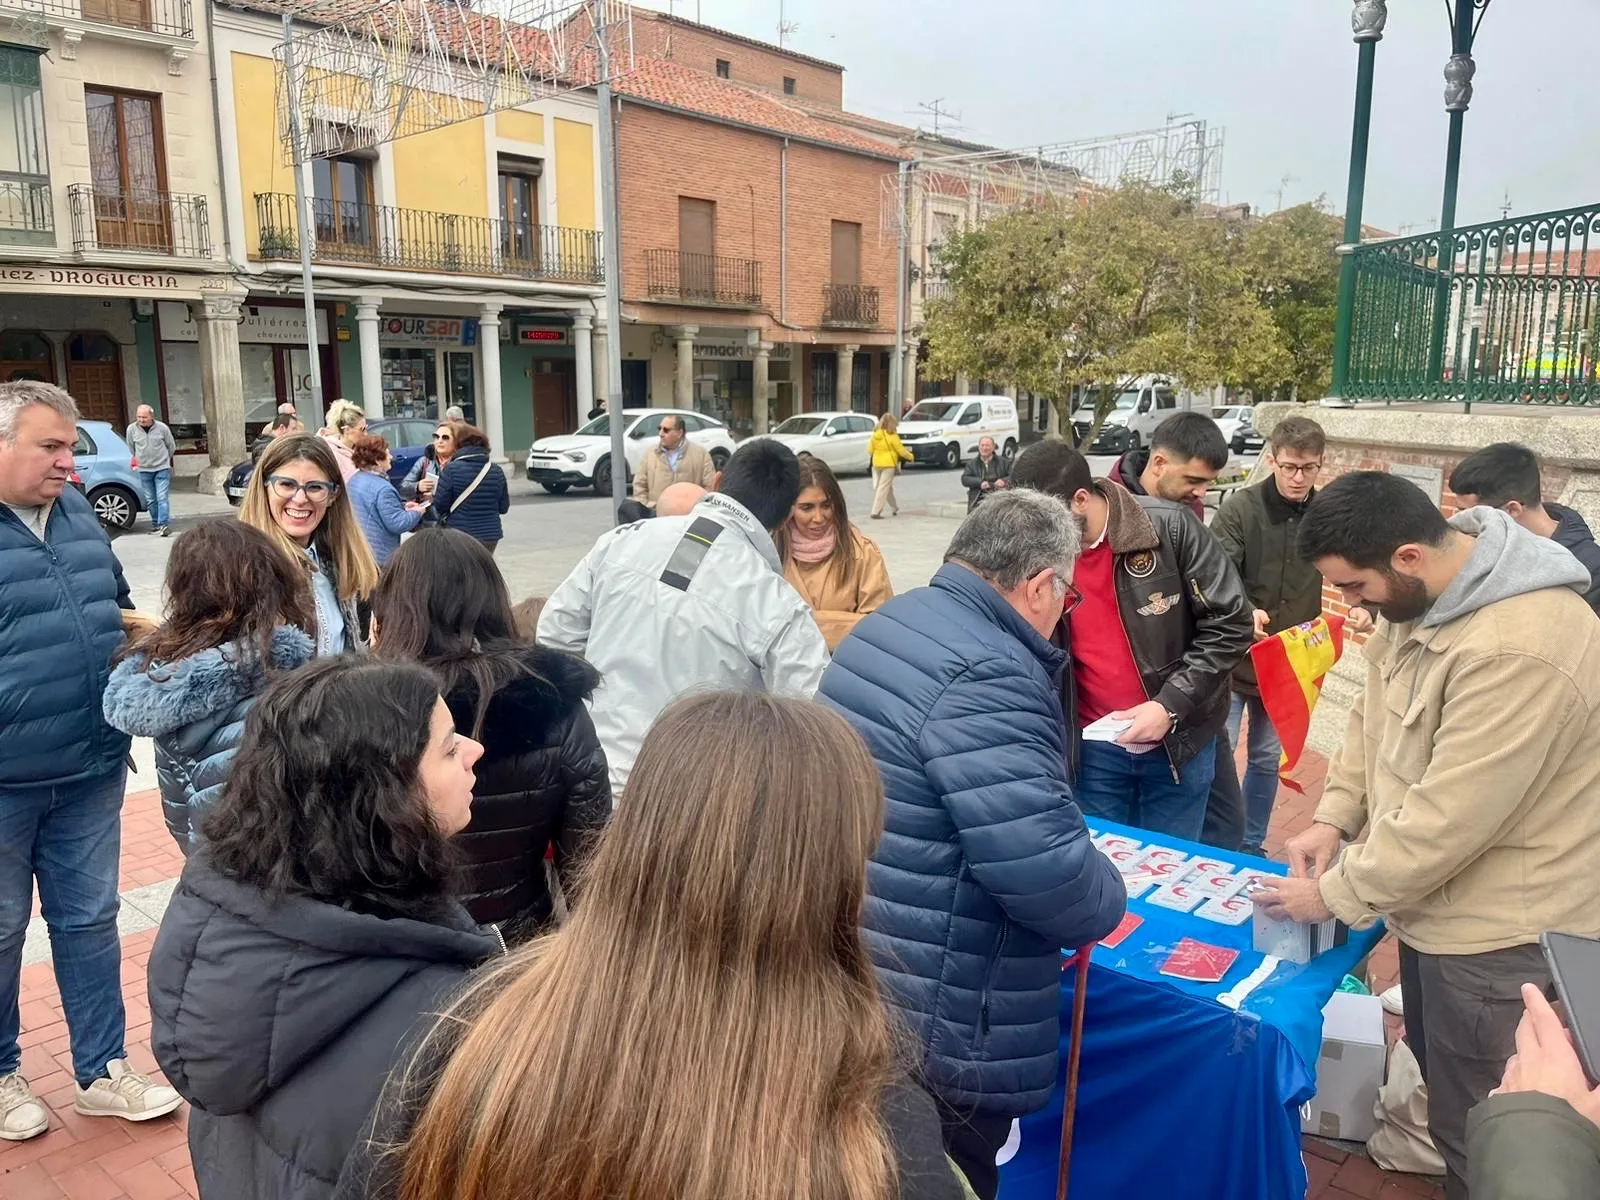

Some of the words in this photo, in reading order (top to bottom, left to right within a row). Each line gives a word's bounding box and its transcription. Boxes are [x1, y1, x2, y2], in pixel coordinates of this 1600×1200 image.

[50, 270, 178, 288] DROGUERIA
[257, 331, 308, 340] charcuteri
[692, 340, 743, 357] armacia
[722, 501, 750, 522] HANSEN
